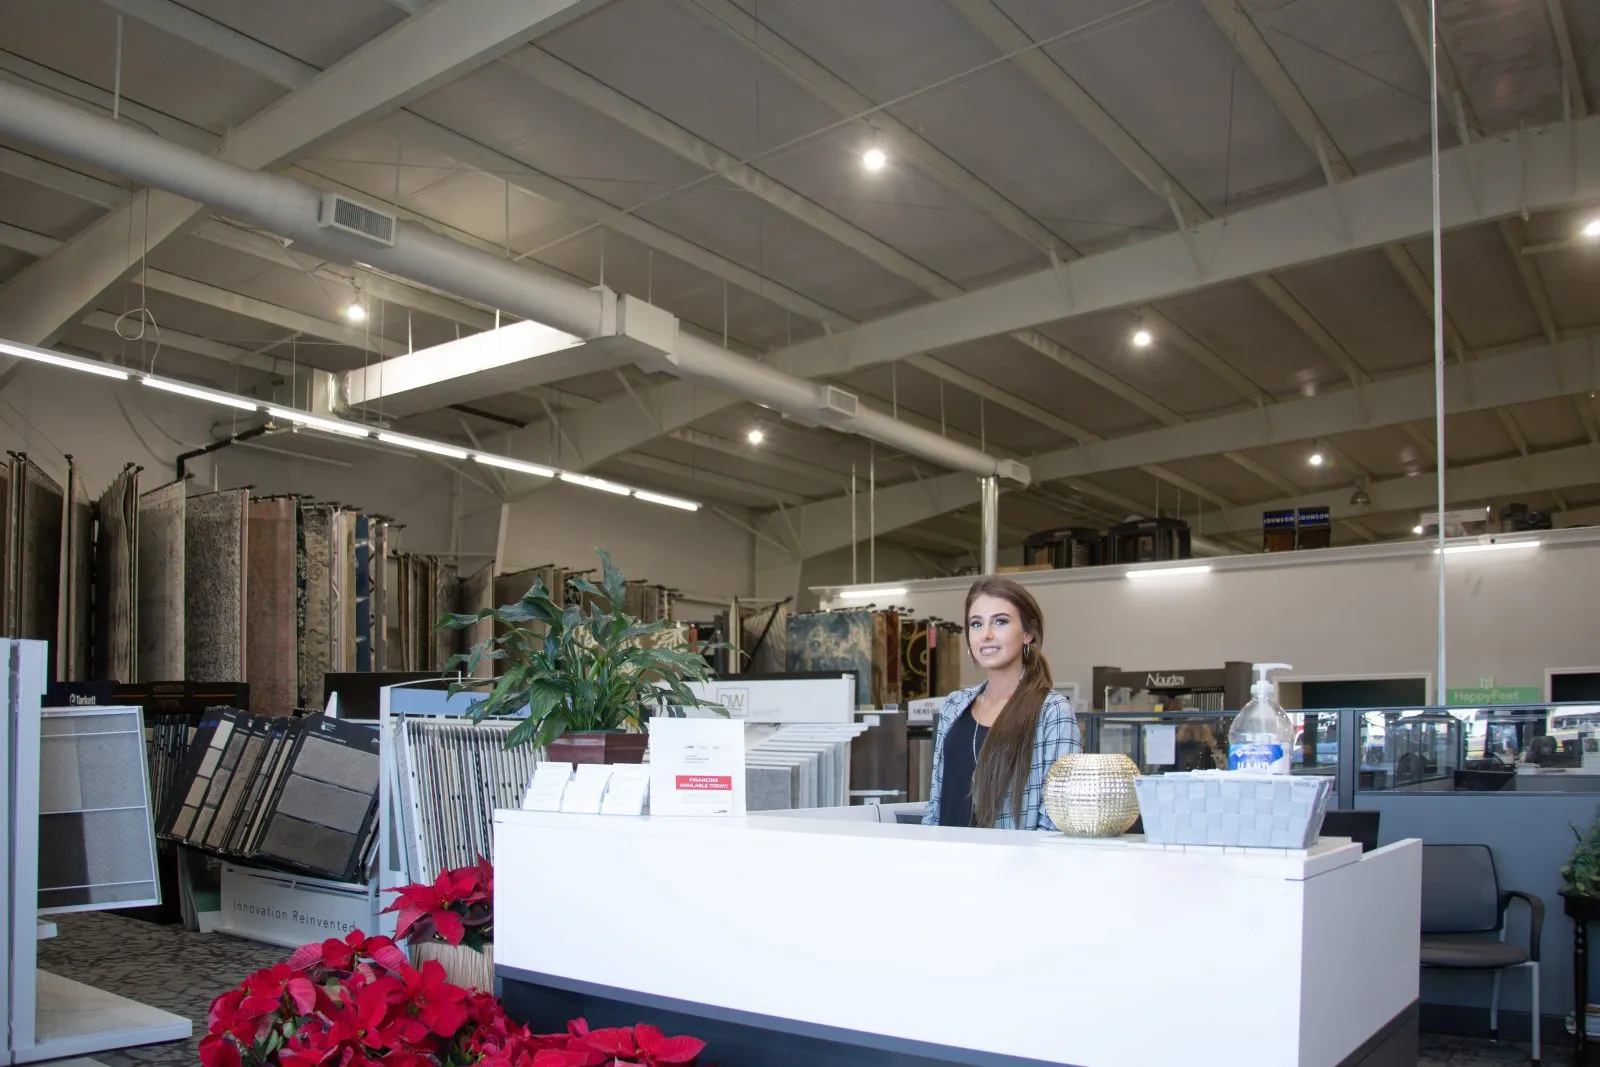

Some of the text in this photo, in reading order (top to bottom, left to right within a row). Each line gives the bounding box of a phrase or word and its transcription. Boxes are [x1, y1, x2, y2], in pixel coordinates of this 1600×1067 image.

[1298, 513, 1329, 521] JOHNSON
[76, 694, 96, 705] Tarkett
[233, 897, 357, 933] Innovation Reinvented
